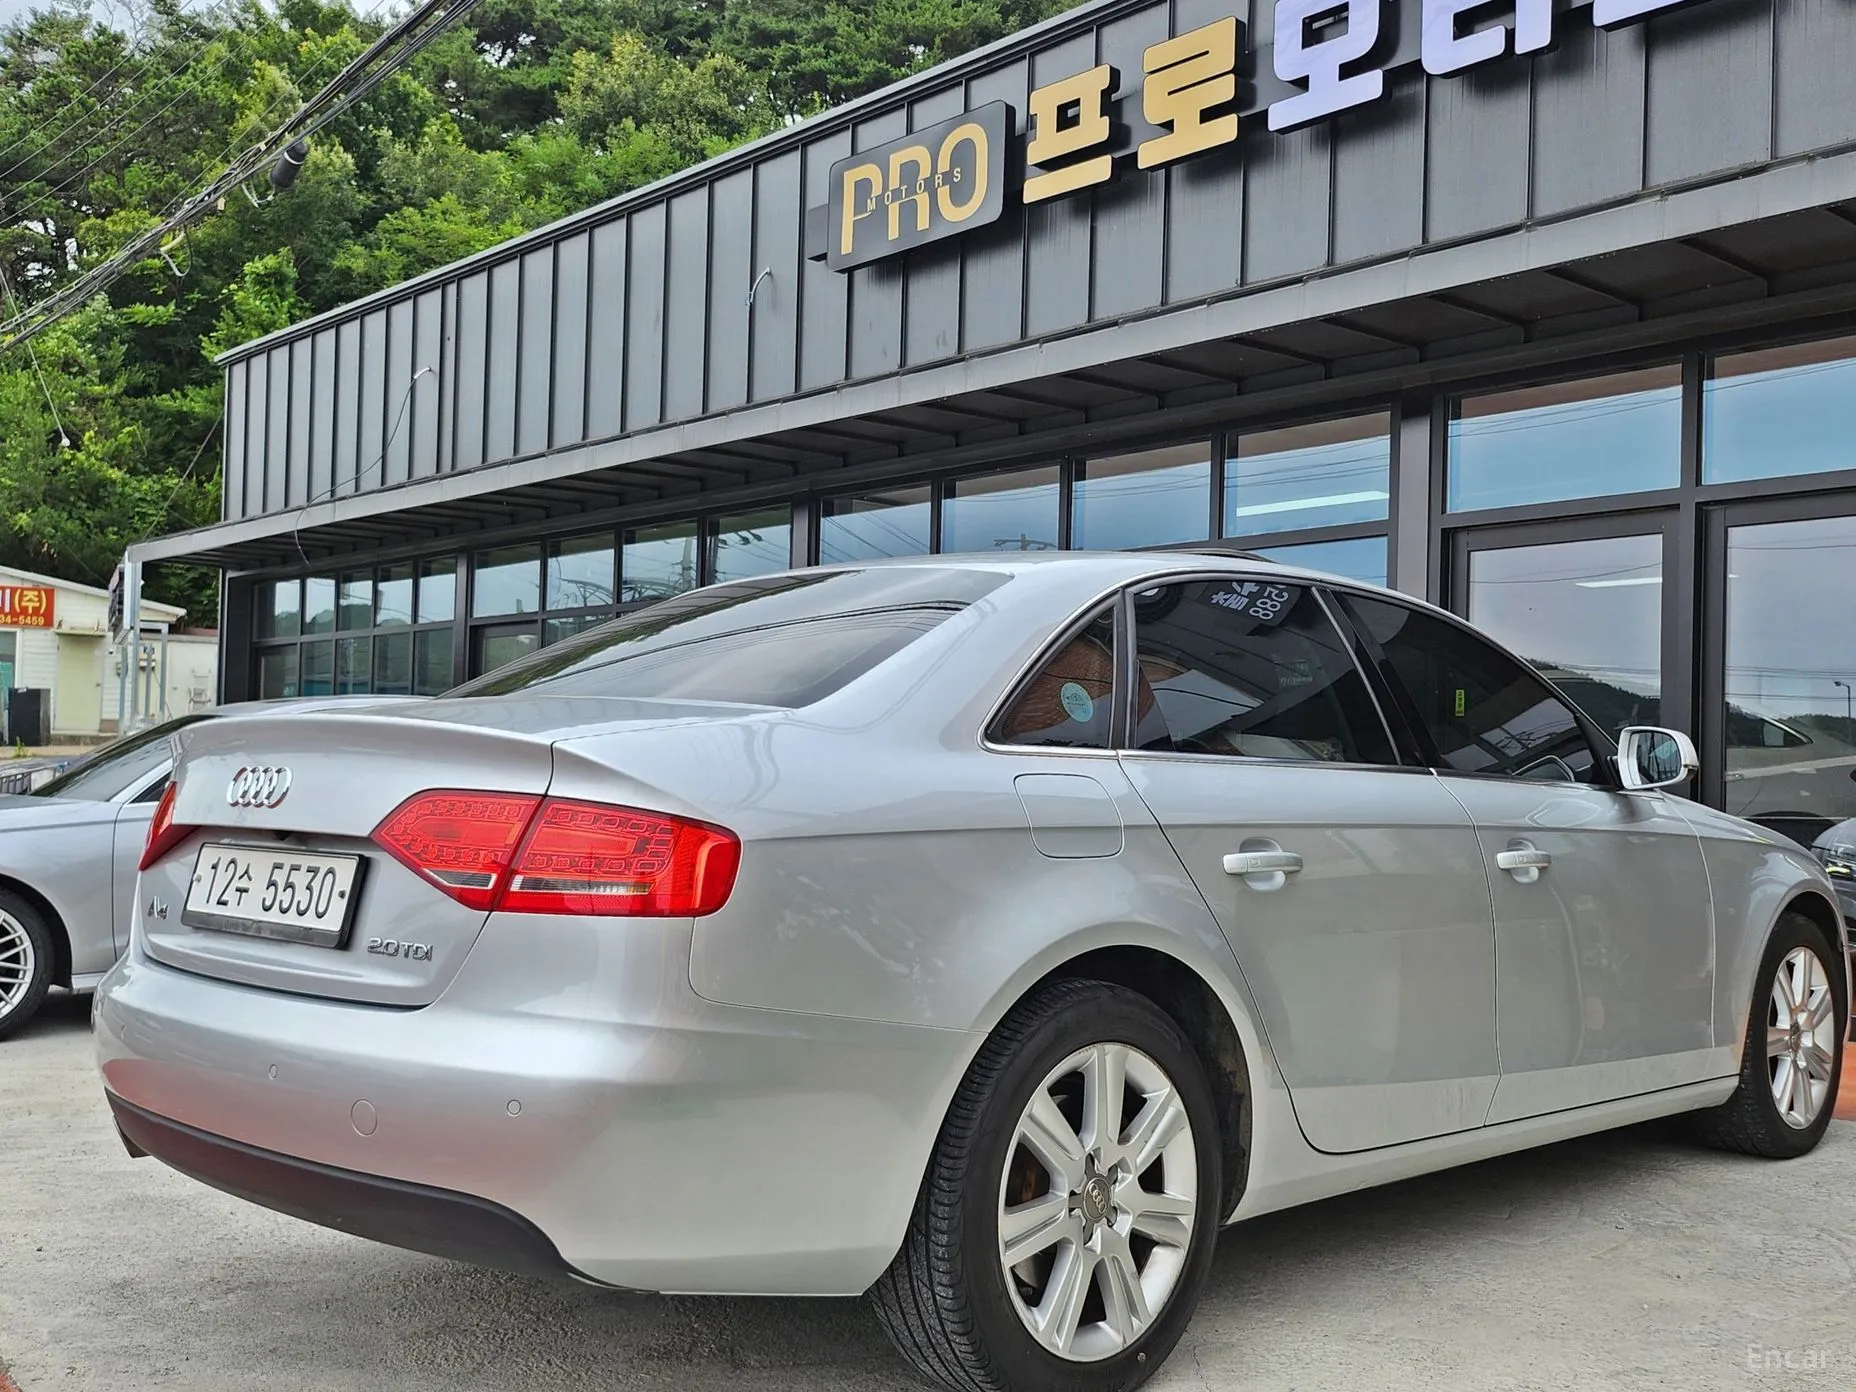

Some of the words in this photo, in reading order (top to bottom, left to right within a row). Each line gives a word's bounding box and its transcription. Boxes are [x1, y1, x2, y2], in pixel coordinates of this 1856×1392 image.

[841, 122, 988, 256] PRO
[866, 167, 962, 212] MOTORS
[147, 895, 169, 920] A4
[206, 856, 252, 907] 12수
[262, 862, 337, 919] 5530
[400, 941, 433, 962] TDI
